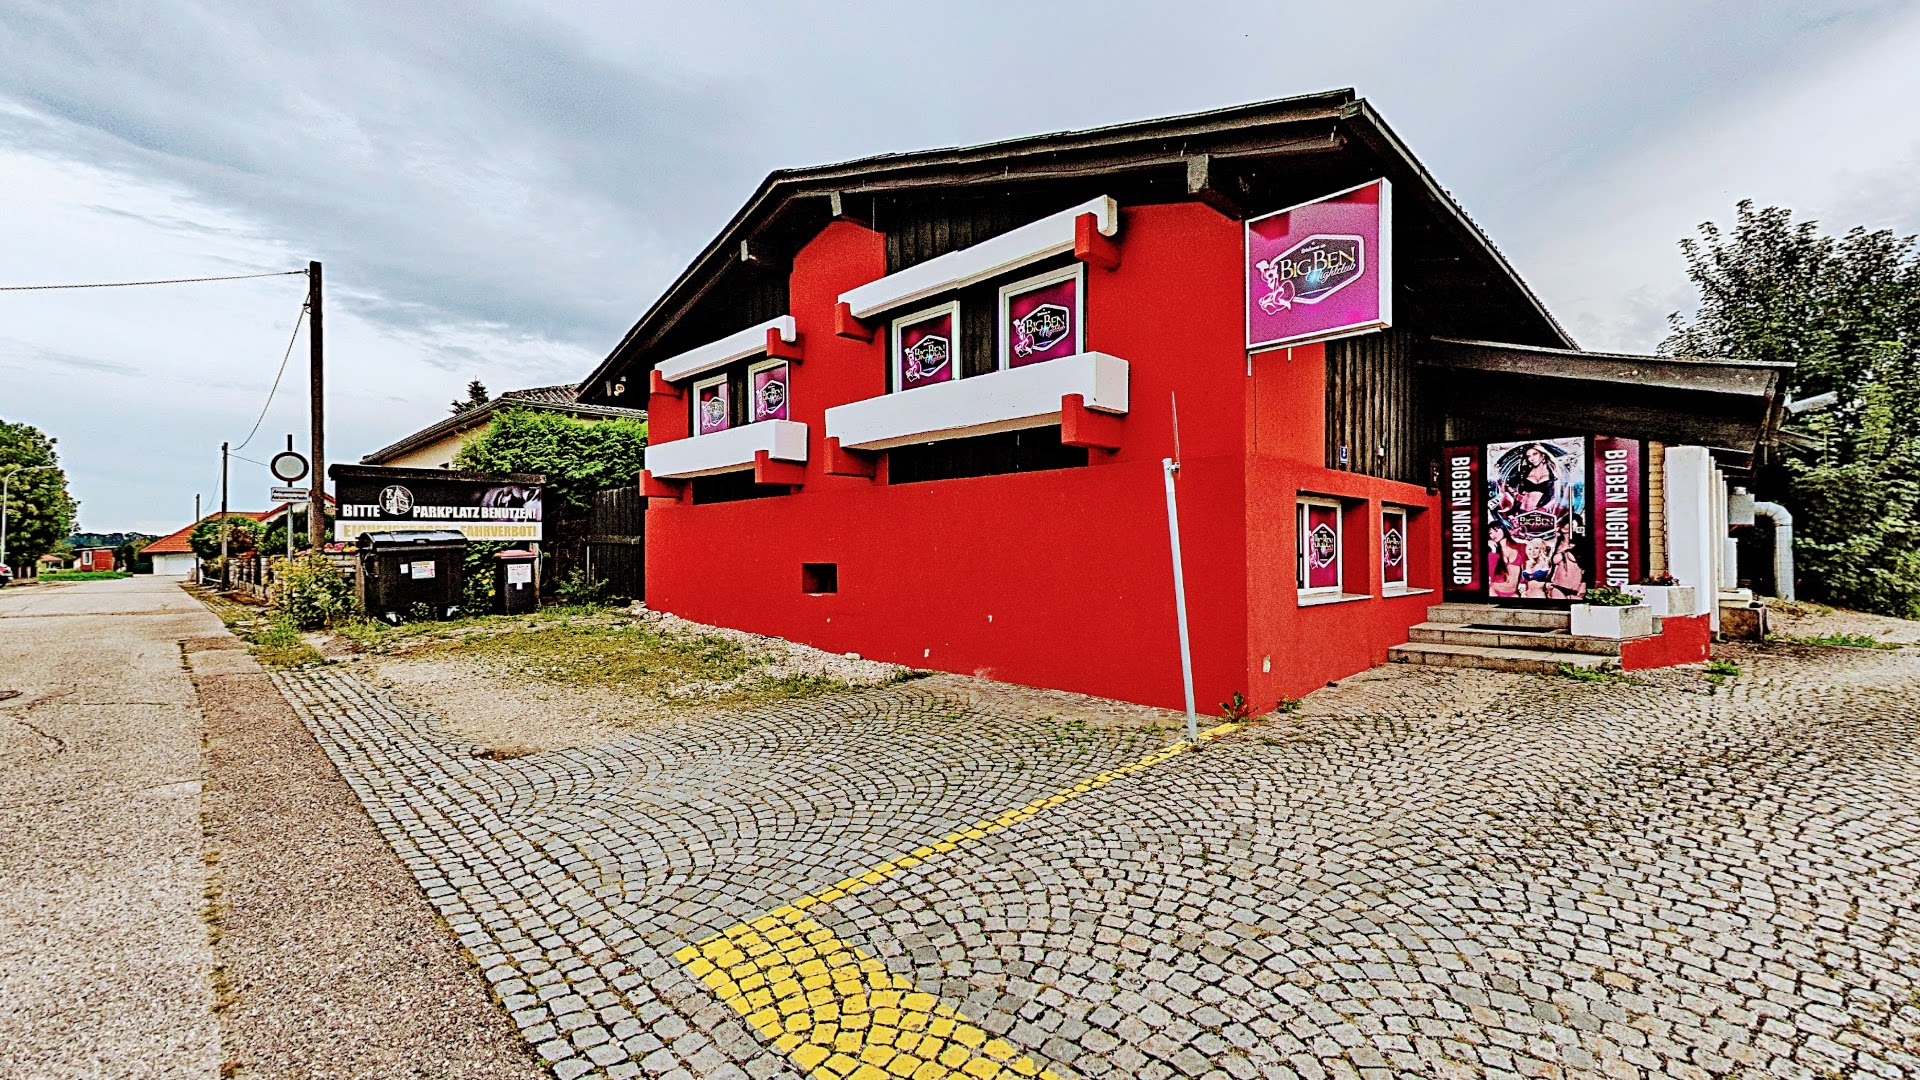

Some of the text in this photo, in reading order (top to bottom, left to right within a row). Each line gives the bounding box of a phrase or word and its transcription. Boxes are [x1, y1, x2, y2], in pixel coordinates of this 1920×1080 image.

[342, 504, 536, 519] BITTE PARKPLATZ BENUTZEN!
